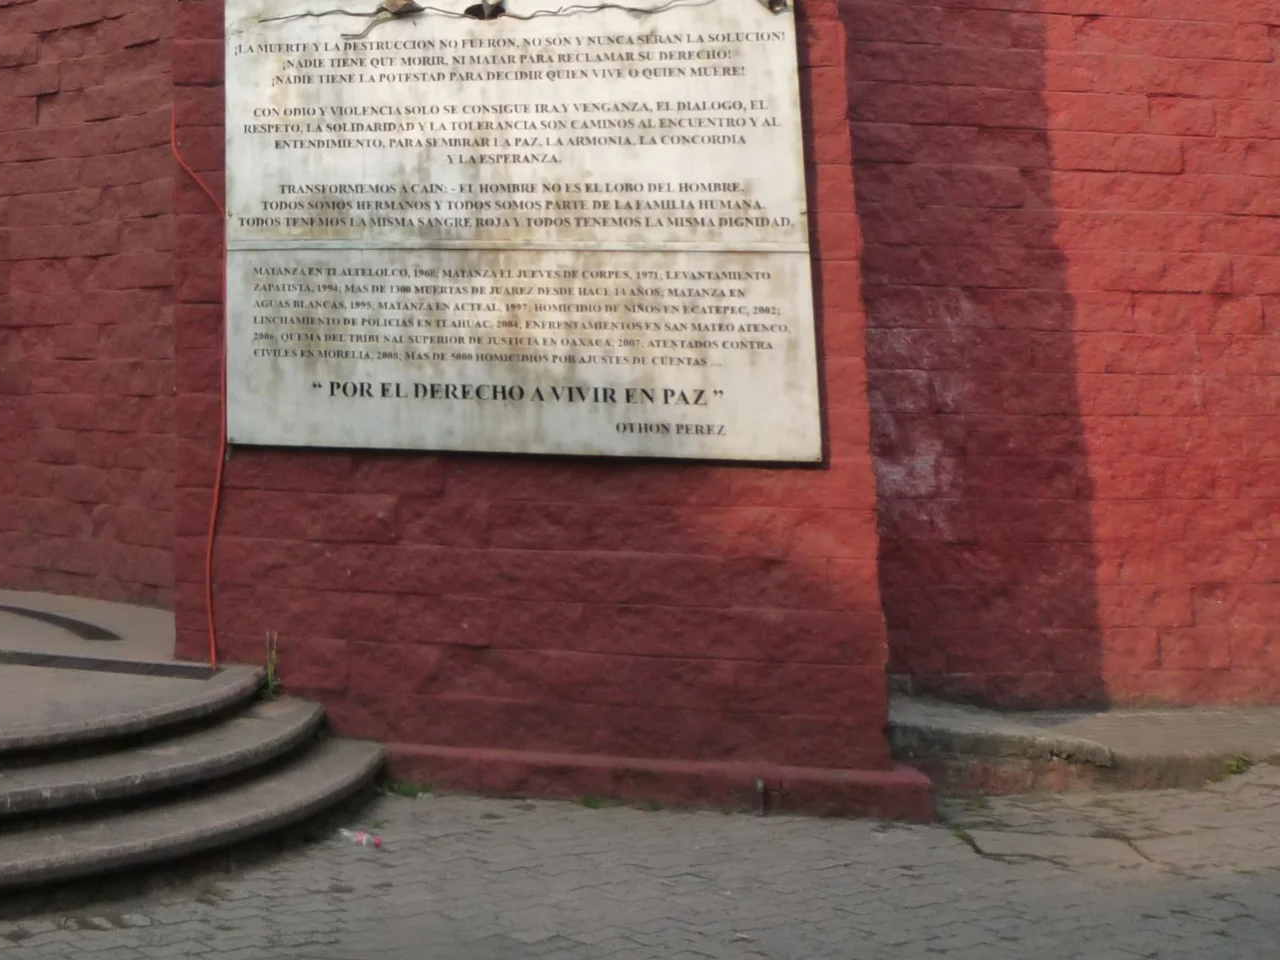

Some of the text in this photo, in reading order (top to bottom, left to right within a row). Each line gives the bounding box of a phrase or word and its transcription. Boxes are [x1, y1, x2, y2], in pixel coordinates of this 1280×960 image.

[258, 43, 309, 53] MUERTE
[313, 42, 320, 52] Y
[324, 42, 340, 52] LA
[344, 40, 435, 51] DESTRUCCION
[440, 39, 458, 49] NO
[523, 38, 541, 47] NO
[545, 37, 571, 47] SON
[576, 37, 582, 46] Y
[586, 35, 632, 46] NUNCA
[686, 34, 704, 43] LA
[330, 58, 366, 68] TIENE
[370, 57, 396, 68] QUE
[452, 56, 466, 65] NI
[470, 55, 516, 65] MATAR
[520, 54, 554, 64] PARA
[558, 52, 634, 63] RECLAMAR
[638, 52, 655, 61] SU
[320, 74, 355, 84] TIENE
[360, 74, 376, 83] LA
[379, 73, 445, 83] POTESTAD
[450, 72, 482, 81] PARA
[487, 71, 542, 81] DECIDIR
[546, 70, 588, 81] QUIEN
[592, 69, 622, 79] VIVE
[629, 69, 638, 78] O
[642, 68, 686, 79] QUIEN
[253, 108, 280, 117] CON
[284, 107, 316, 117] ODIO
[320, 107, 327, 116] Y
[331, 106, 401, 116] VIOLENCIA
[405, 105, 439, 115] SOLO
[444, 105, 458, 114] SE
[462, 104, 530, 114] CONSIGUE
[534, 104, 558, 113] IRA
[559, 103, 568, 113] Y
[656, 102, 674, 112] EL
[750, 100, 768, 110] EL
[307, 124, 322, 132] LA
[326, 122, 414, 132] SOLIDARIDAD
[418, 122, 426, 131] Y
[430, 122, 446, 131] LA
[450, 121, 537, 131] TOLERANCIA
[540, 120, 567, 129] SON
[571, 119, 634, 129] CAMINOS
[638, 119, 655, 128] AL
[659, 118, 746, 128] ENCUENTRO
[750, 118, 758, 127] Y
[762, 117, 780, 127] AL
[389, 139, 422, 148] PARA
[426, 138, 490, 148] SEMBRAR
[494, 137, 511, 147] LA
[546, 137, 563, 146] LA
[640, 136, 658, 145] LA
[661, 134, 746, 145] CONCORDIA
[447, 154, 454, 163] Y
[459, 154, 476, 163] LA
[279, 184, 396, 194] TRANSFORMEMOS
[460, 184, 476, 193] EL
[480, 184, 538, 193] HOMBRE
[542, 184, 561, 192] NO
[585, 183, 602, 192] EL
[606, 183, 644, 192] LOBO
[262, 201, 304, 210] TODOS
[308, 201, 352, 210] SOMOS
[356, 201, 430, 210] HERMANOS
[434, 201, 442, 210] Y
[447, 201, 491, 210] TODOS
[495, 200, 542, 210] SOMOS
[546, 200, 588, 210] PARTE
[592, 200, 610, 210] DE
[614, 200, 631, 210] LA
[635, 200, 695, 210] FAMILIA
[239, 217, 281, 227] TODOS
[370, 217, 414, 227] MISMA
[418, 217, 470, 227] SANGRE
[476, 217, 509, 227] ROJA
[511, 217, 519, 227] Y
[526, 217, 571, 227] TODOS
[575, 217, 641, 227] TENEMOS
[645, 217, 663, 227] LA
[668, 217, 715, 227] MISMA
[329, 381, 373, 398] POR
[380, 382, 408, 398] EL
[414, 384, 524, 401] DERECHO
[531, 386, 545, 402] A
[550, 386, 617, 403] VIVIR
[626, 388, 655, 404] EN
[616, 423, 726, 436] OTHON PEREZ
